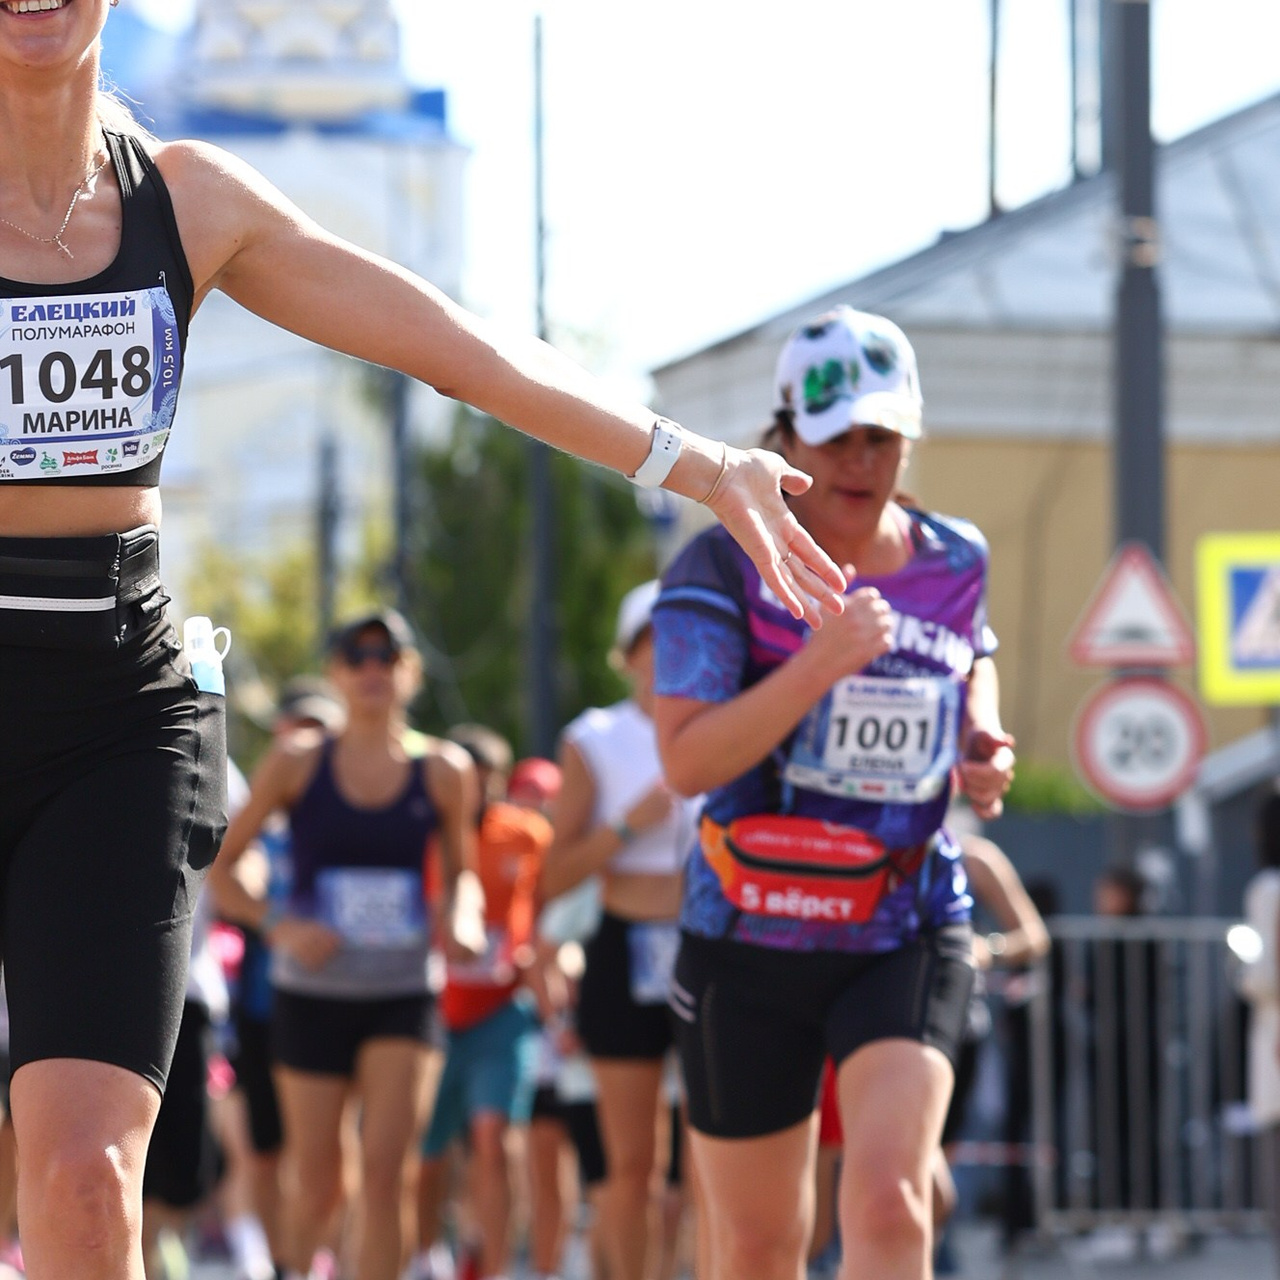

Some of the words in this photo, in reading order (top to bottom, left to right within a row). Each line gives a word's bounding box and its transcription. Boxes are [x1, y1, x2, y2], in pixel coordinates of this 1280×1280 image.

[11, 296, 136, 323] ЕЛЕЦКИЙ
[12, 322, 135, 341] ПОЛУМАРАФОН
[163, 354, 175, 388] 10,5
[22, 406, 133, 434] МАРИНА
[834, 715, 929, 752] 1001
[740, 882, 761, 911] 5
